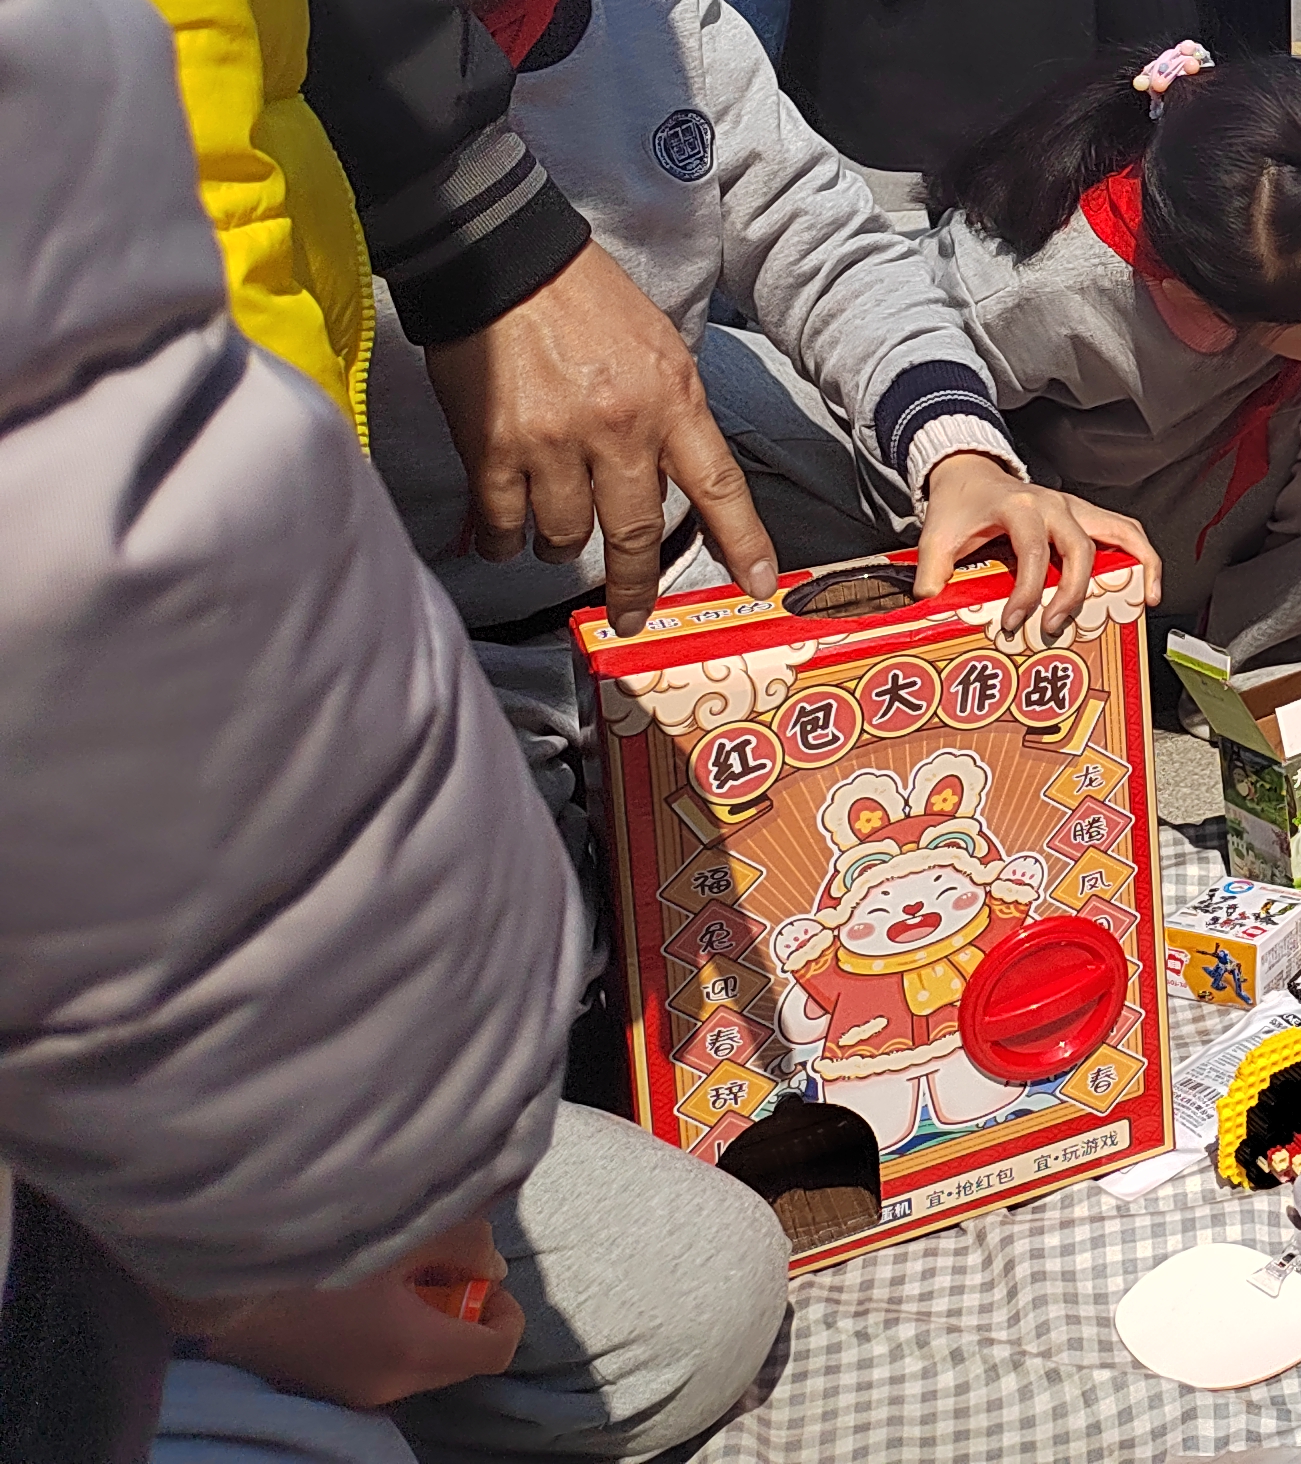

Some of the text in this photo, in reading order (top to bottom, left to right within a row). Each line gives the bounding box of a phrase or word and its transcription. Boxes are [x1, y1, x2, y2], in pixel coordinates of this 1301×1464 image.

[707, 663, 1073, 792] 红包大作战
[691, 866, 748, 1163] 福兔迎春辞
